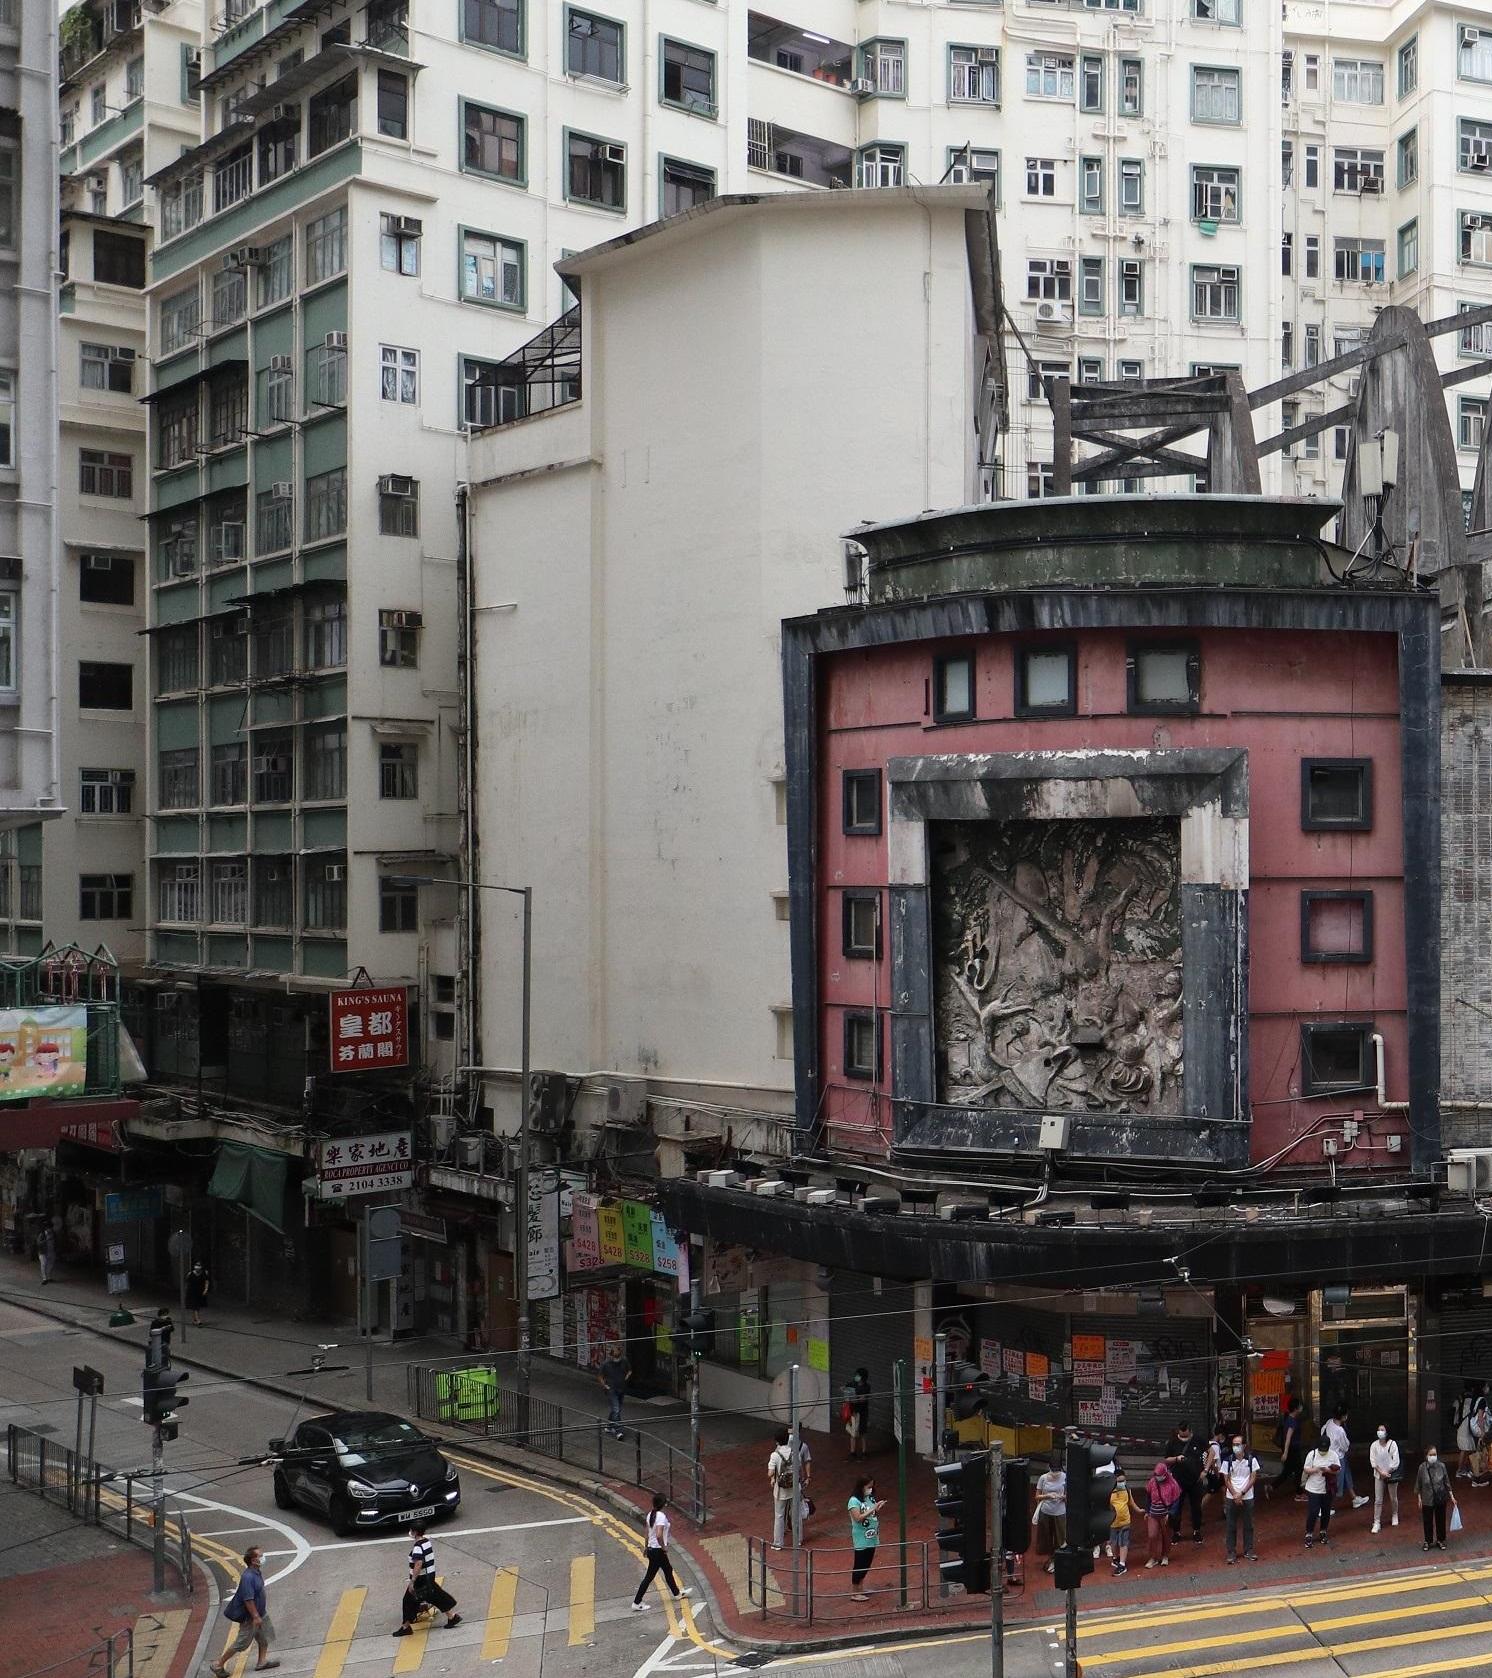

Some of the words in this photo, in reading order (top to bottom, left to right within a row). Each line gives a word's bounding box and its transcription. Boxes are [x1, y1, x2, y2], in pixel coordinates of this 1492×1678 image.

[337, 996, 370, 1006] KING'S
[371, 993, 402, 1004] SAUNA
[338, 1011, 393, 1038] 皇都
[325, 1137, 409, 1165] 樂家地產
[349, 1179, 374, 1191] 2104
[378, 1175, 403, 1187] 3338
[580, 1256, 605, 1268] $328
[657, 1257, 677, 1270] $258
